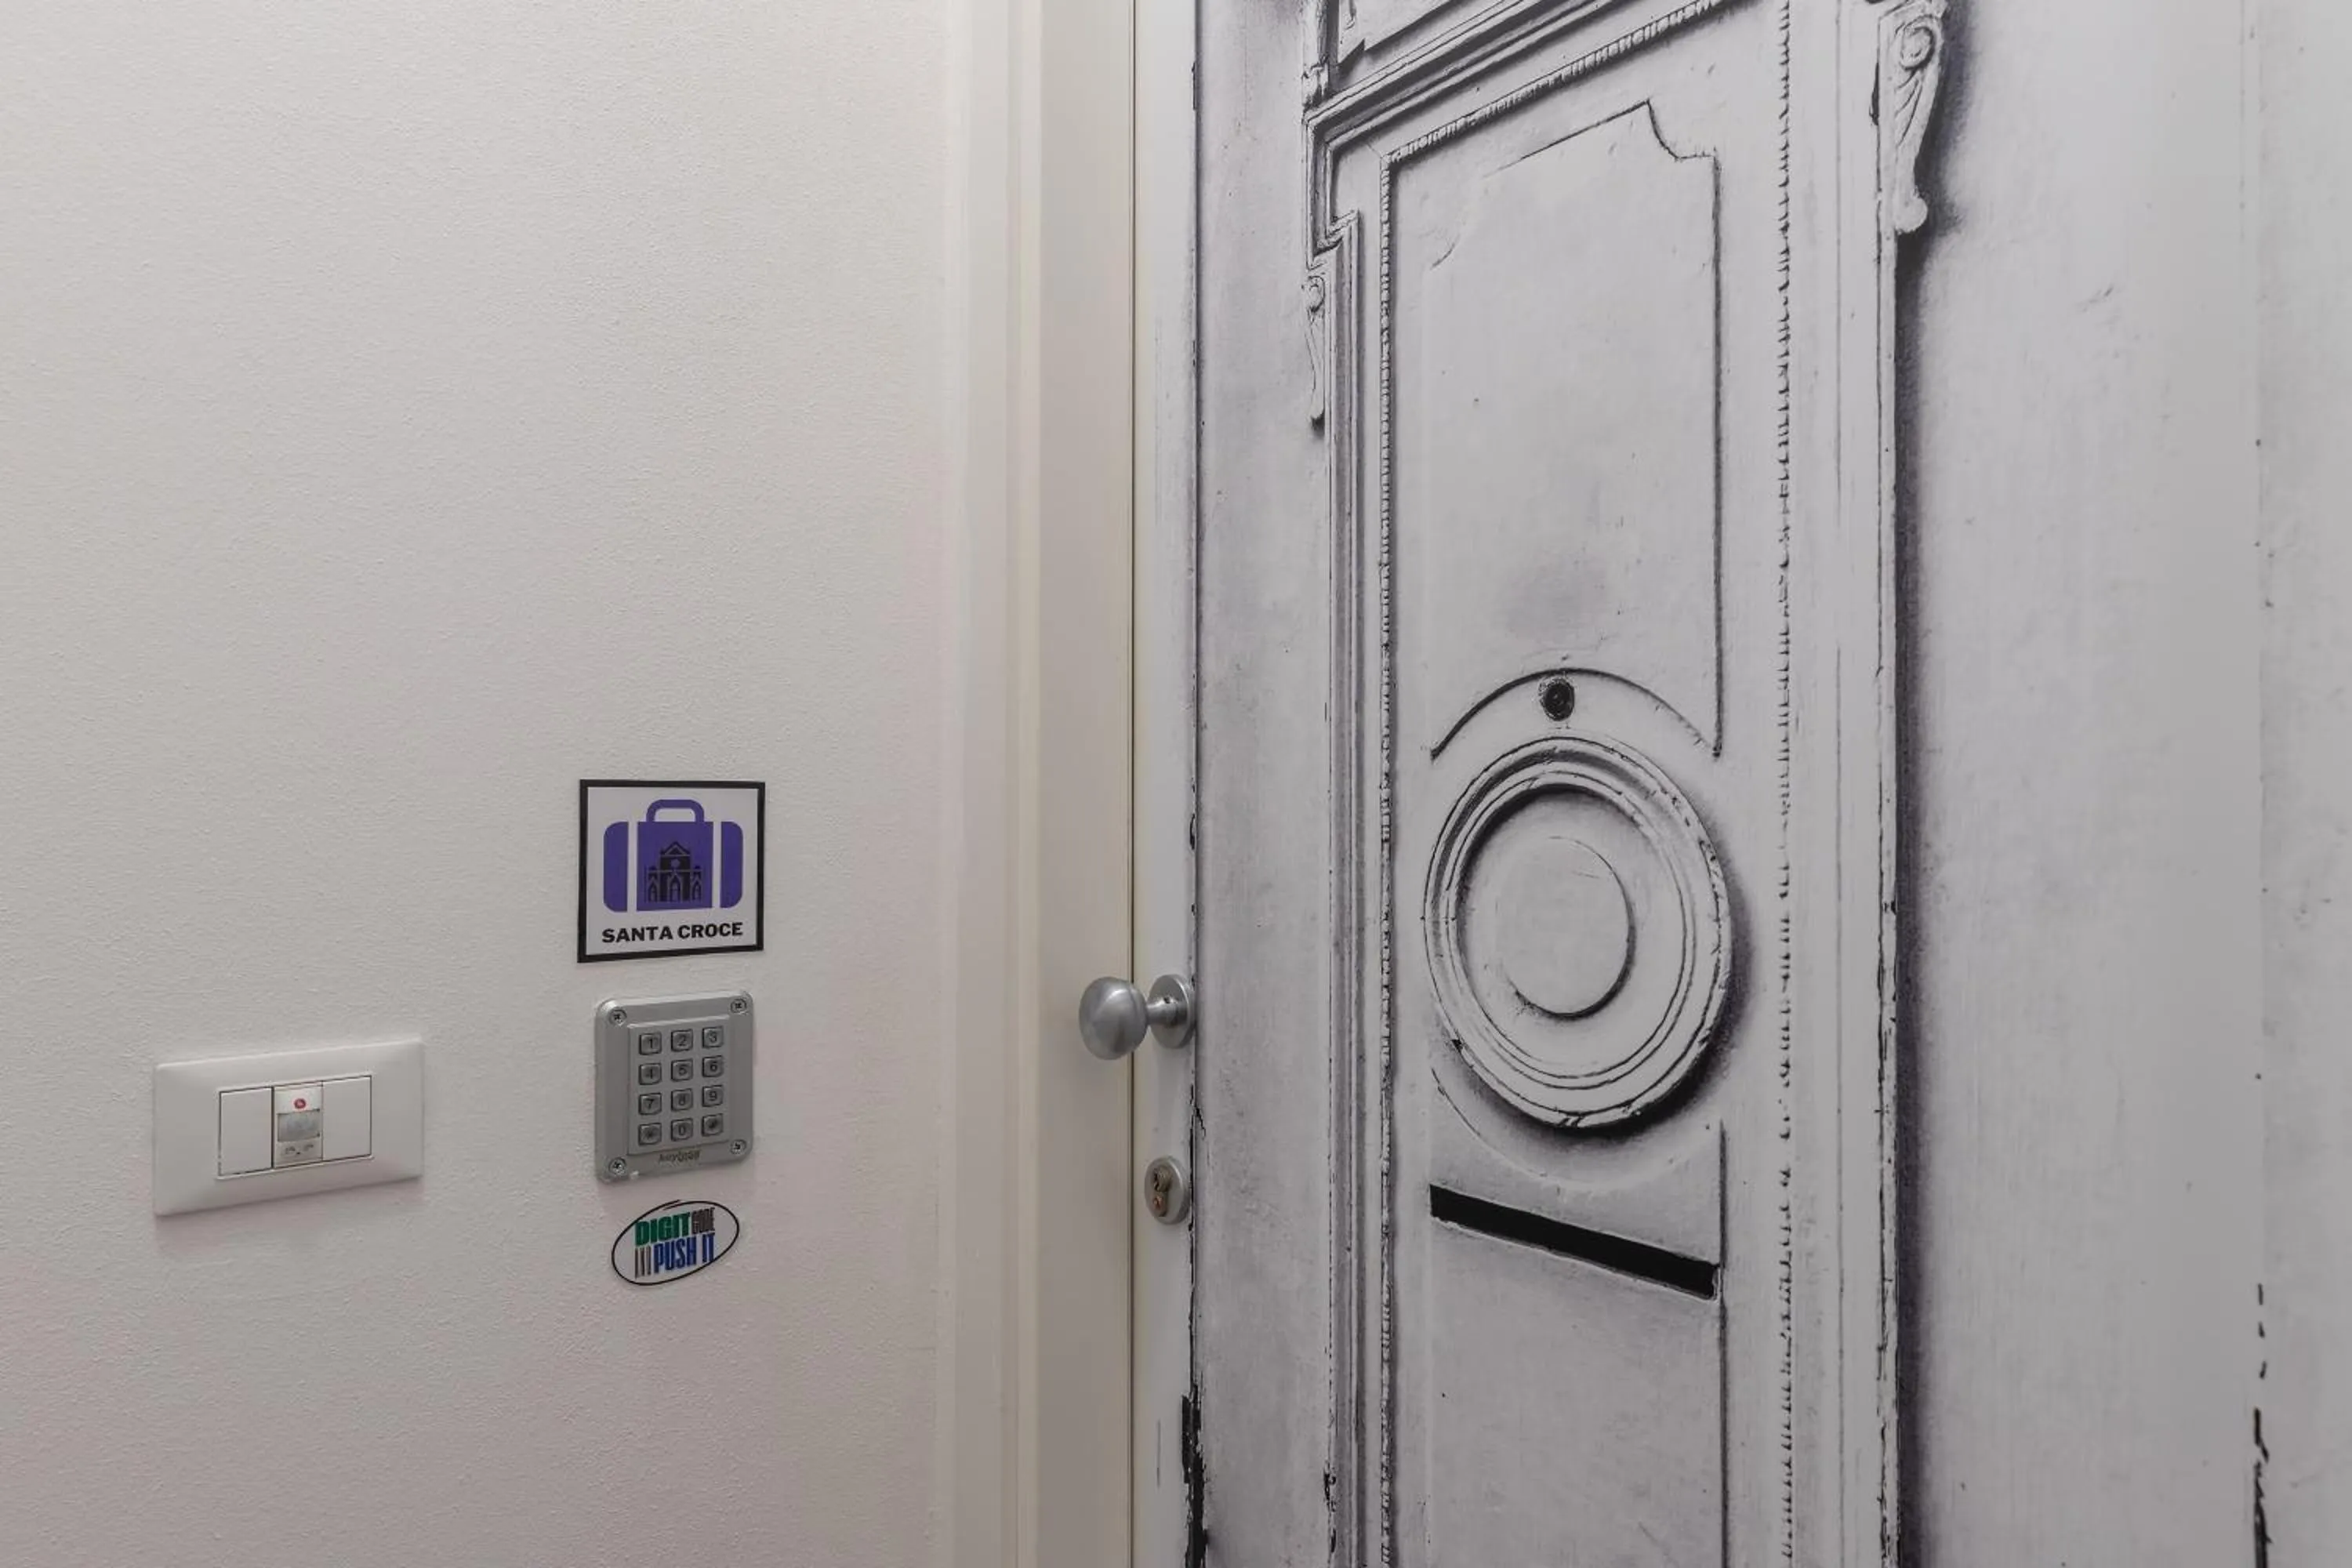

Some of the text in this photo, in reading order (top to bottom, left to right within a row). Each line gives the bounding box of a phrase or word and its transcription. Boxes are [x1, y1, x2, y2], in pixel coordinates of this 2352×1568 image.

[601, 922, 743, 943] SANTA CROCE
[677, 1034, 687, 1047] 2
[708, 1031, 717, 1043] 3
[677, 1064, 687, 1076] 5
[710, 1061, 717, 1073] 6
[645, 1090, 717, 1111] 7 8 9
[635, 1212, 690, 1245] DIGIT
[654, 1232, 715, 1273] PUSH IT
